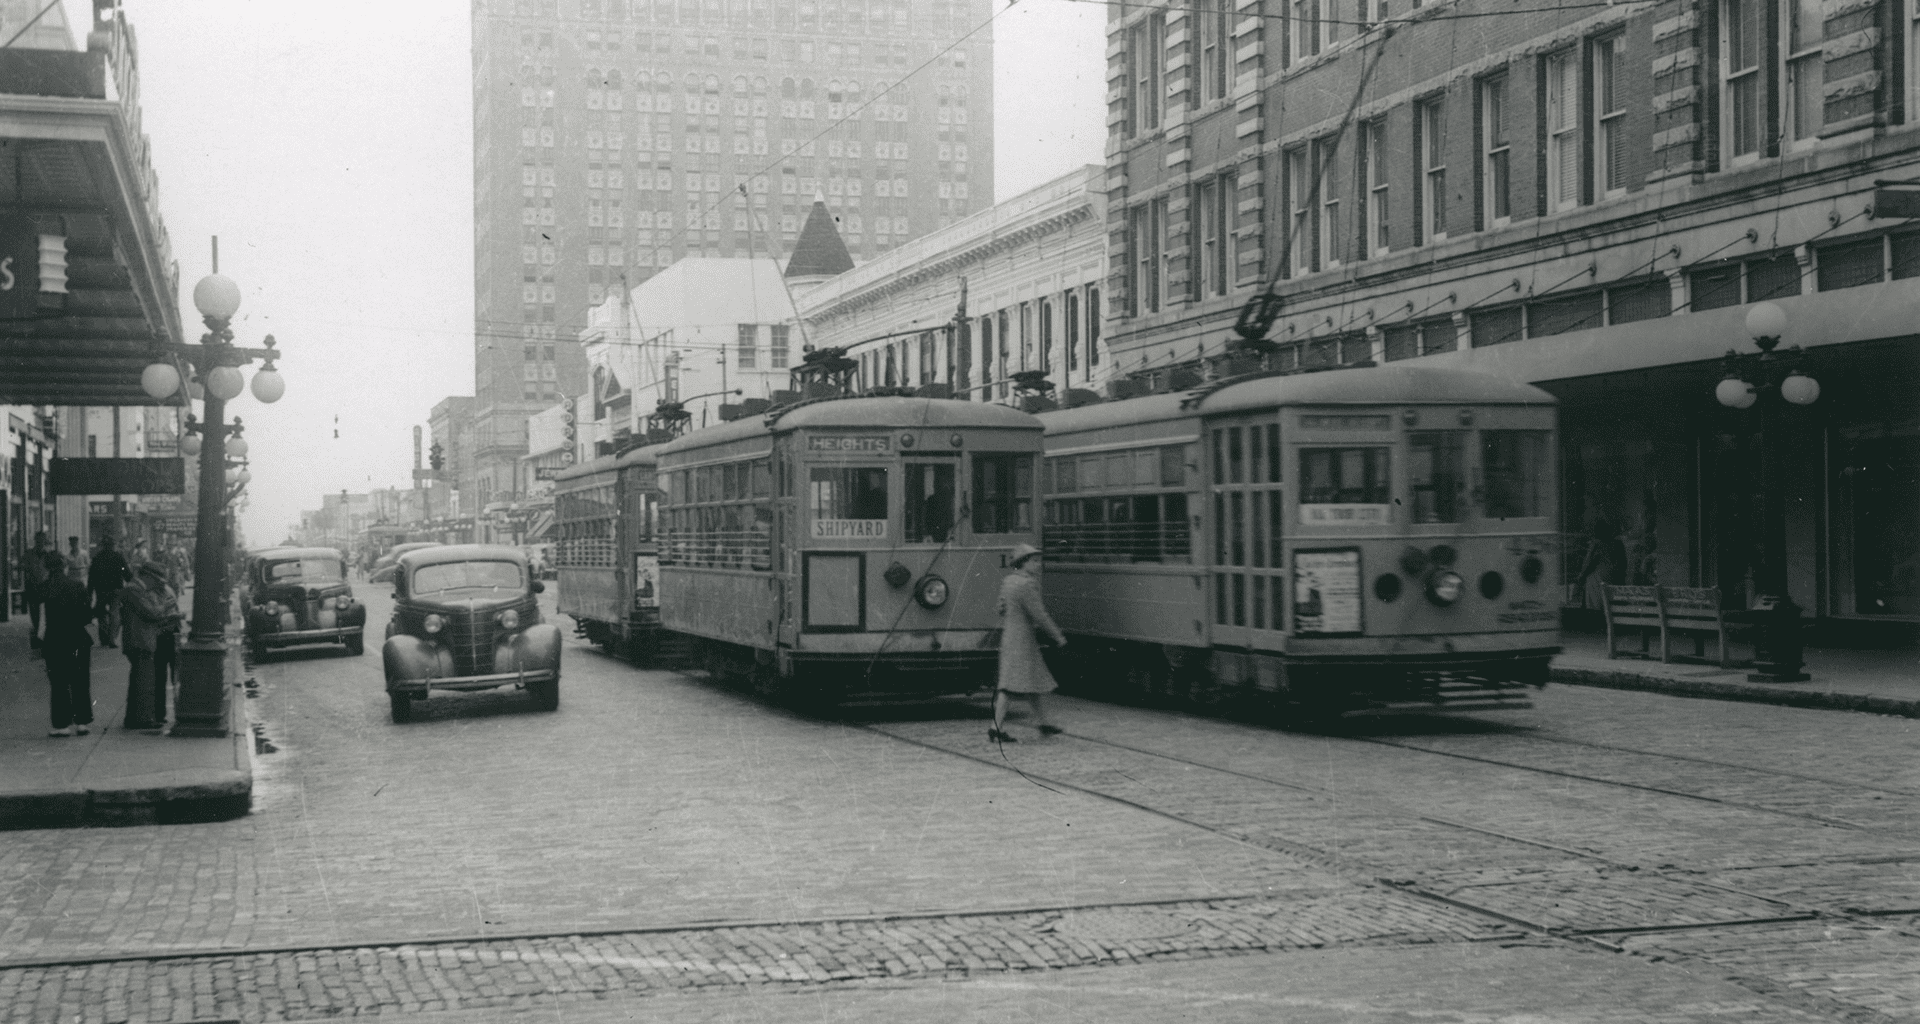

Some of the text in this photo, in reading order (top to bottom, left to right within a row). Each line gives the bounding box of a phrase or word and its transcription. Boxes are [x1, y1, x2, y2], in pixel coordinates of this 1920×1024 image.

[1, 256, 15, 291] S
[812, 438, 886, 451] HEIGHTS
[816, 521, 884, 537] SHIPYARD
